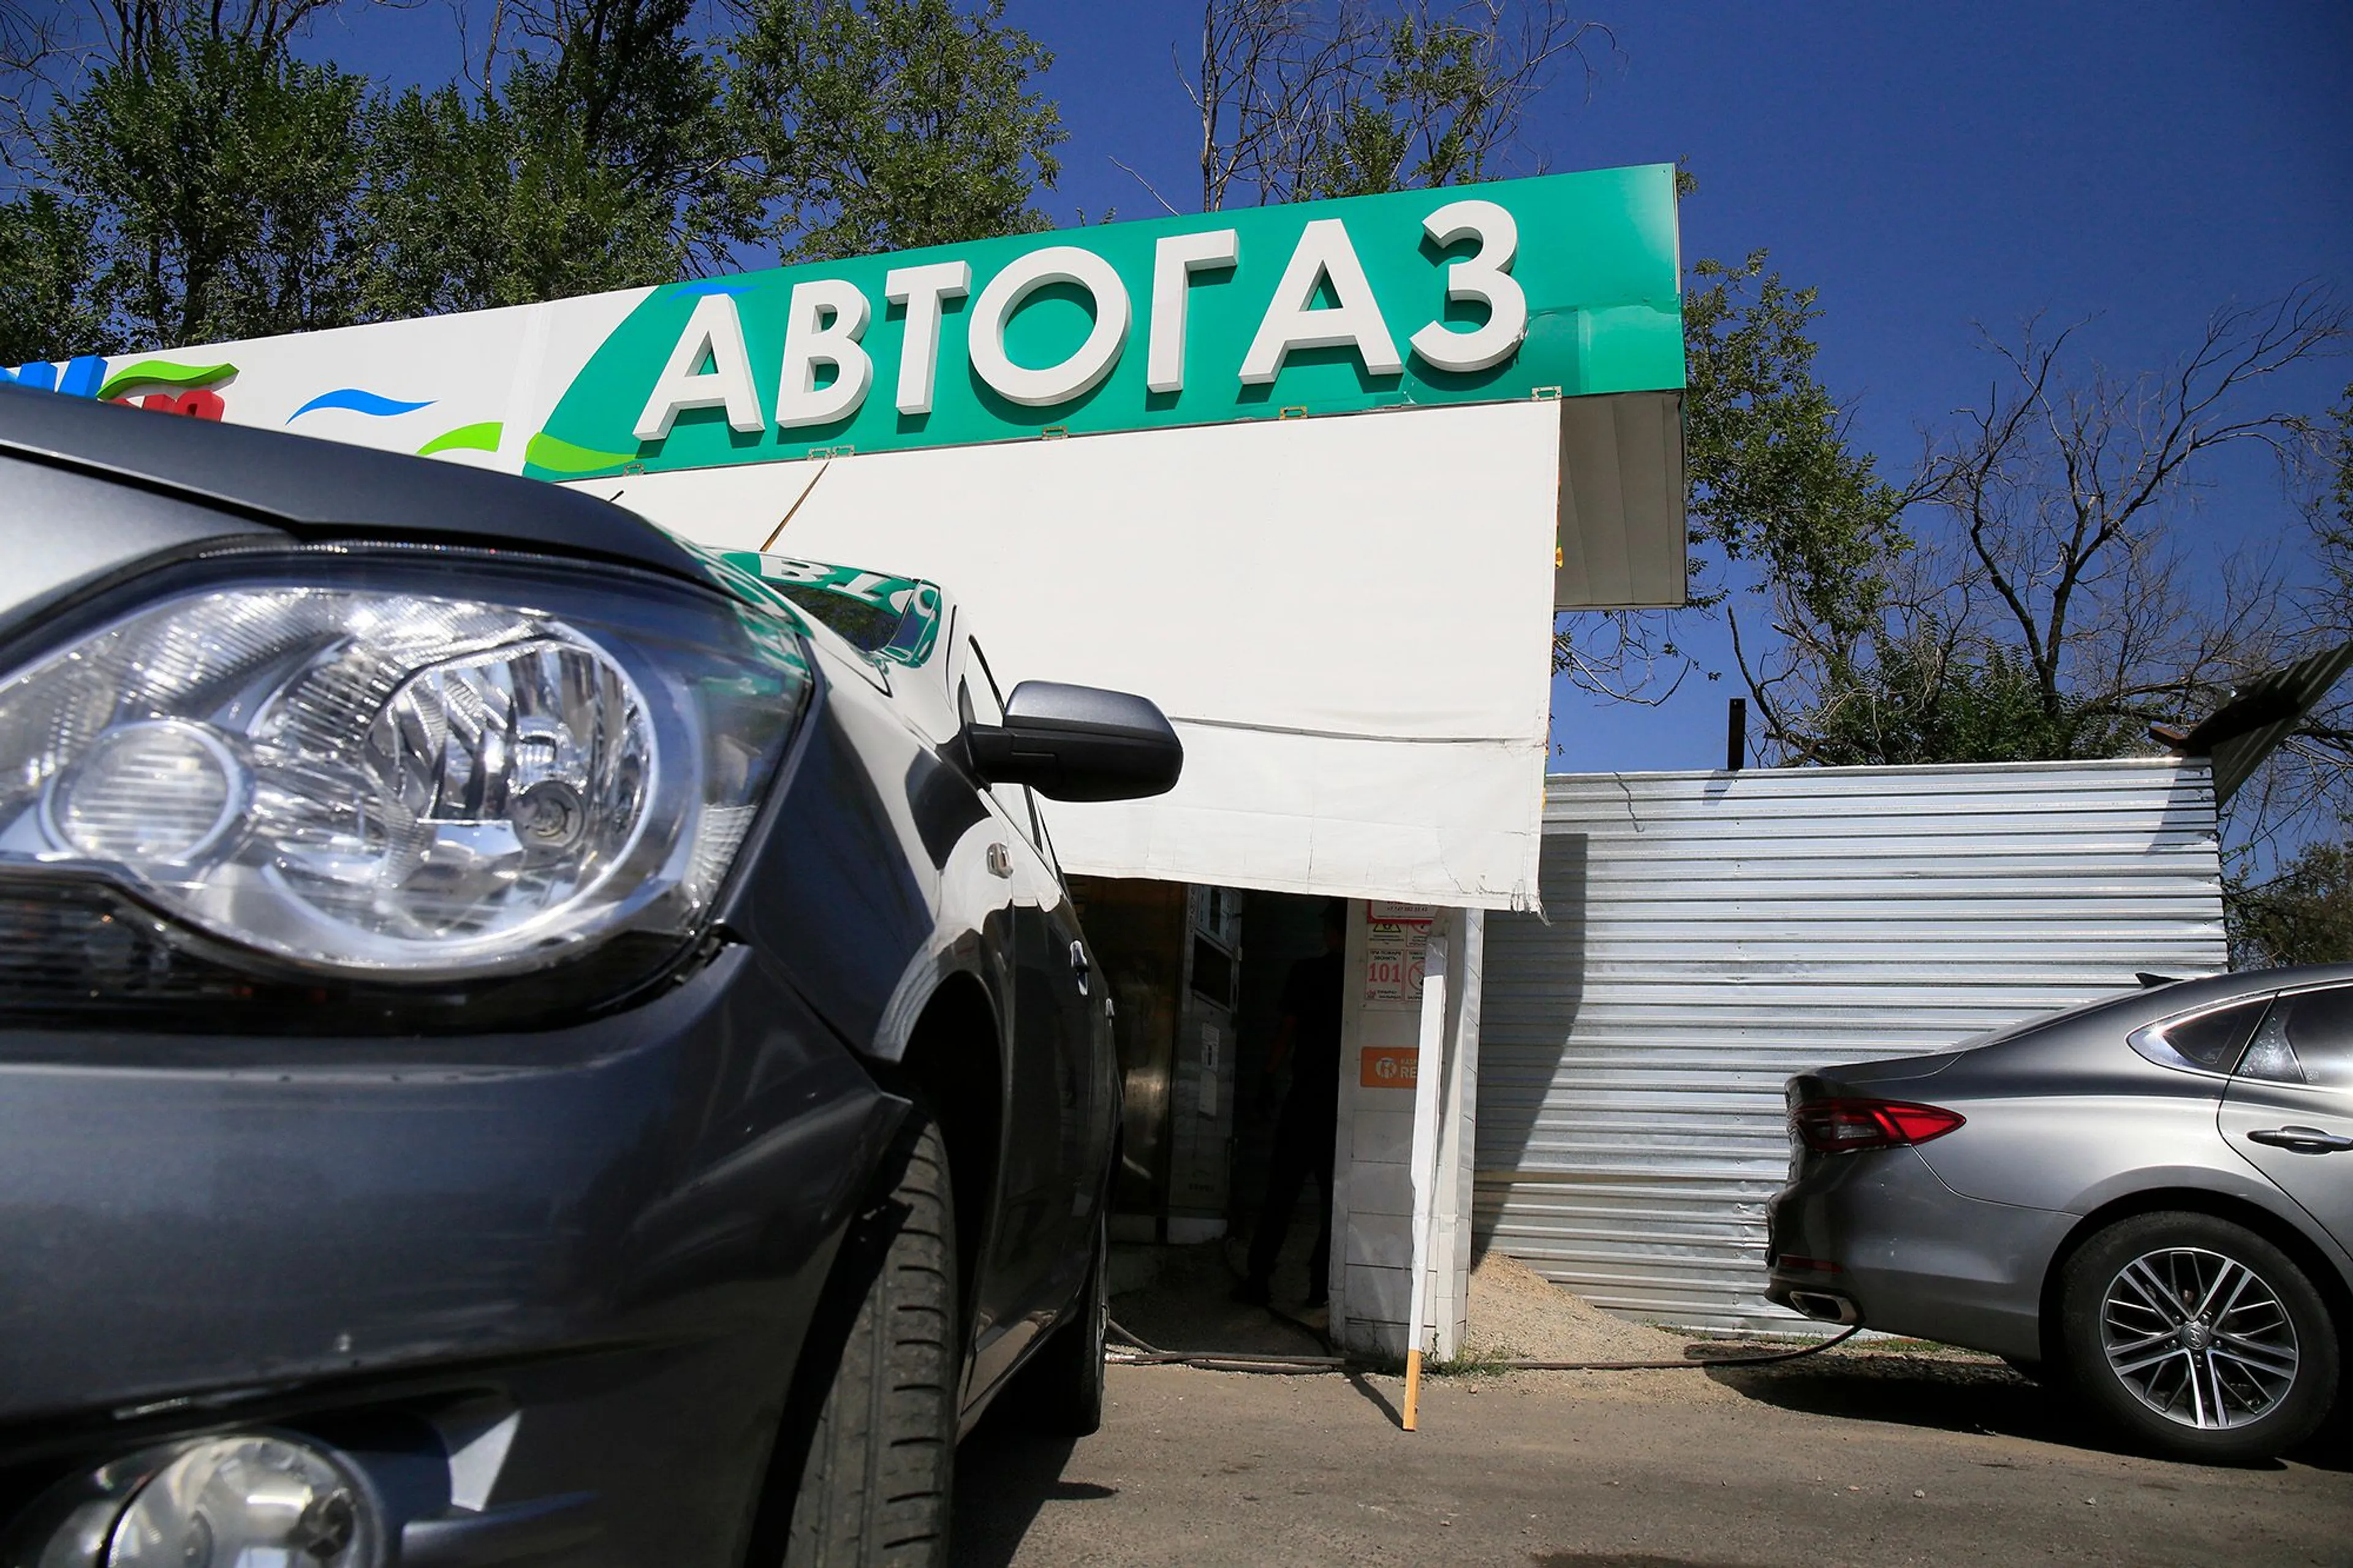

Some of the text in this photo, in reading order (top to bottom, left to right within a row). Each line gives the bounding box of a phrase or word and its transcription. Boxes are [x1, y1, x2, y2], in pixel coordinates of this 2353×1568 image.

[633, 200, 1527, 441] АВТОГАЗ
[1368, 962, 1401, 983] 101
[1400, 1066, 1416, 1078] RE
